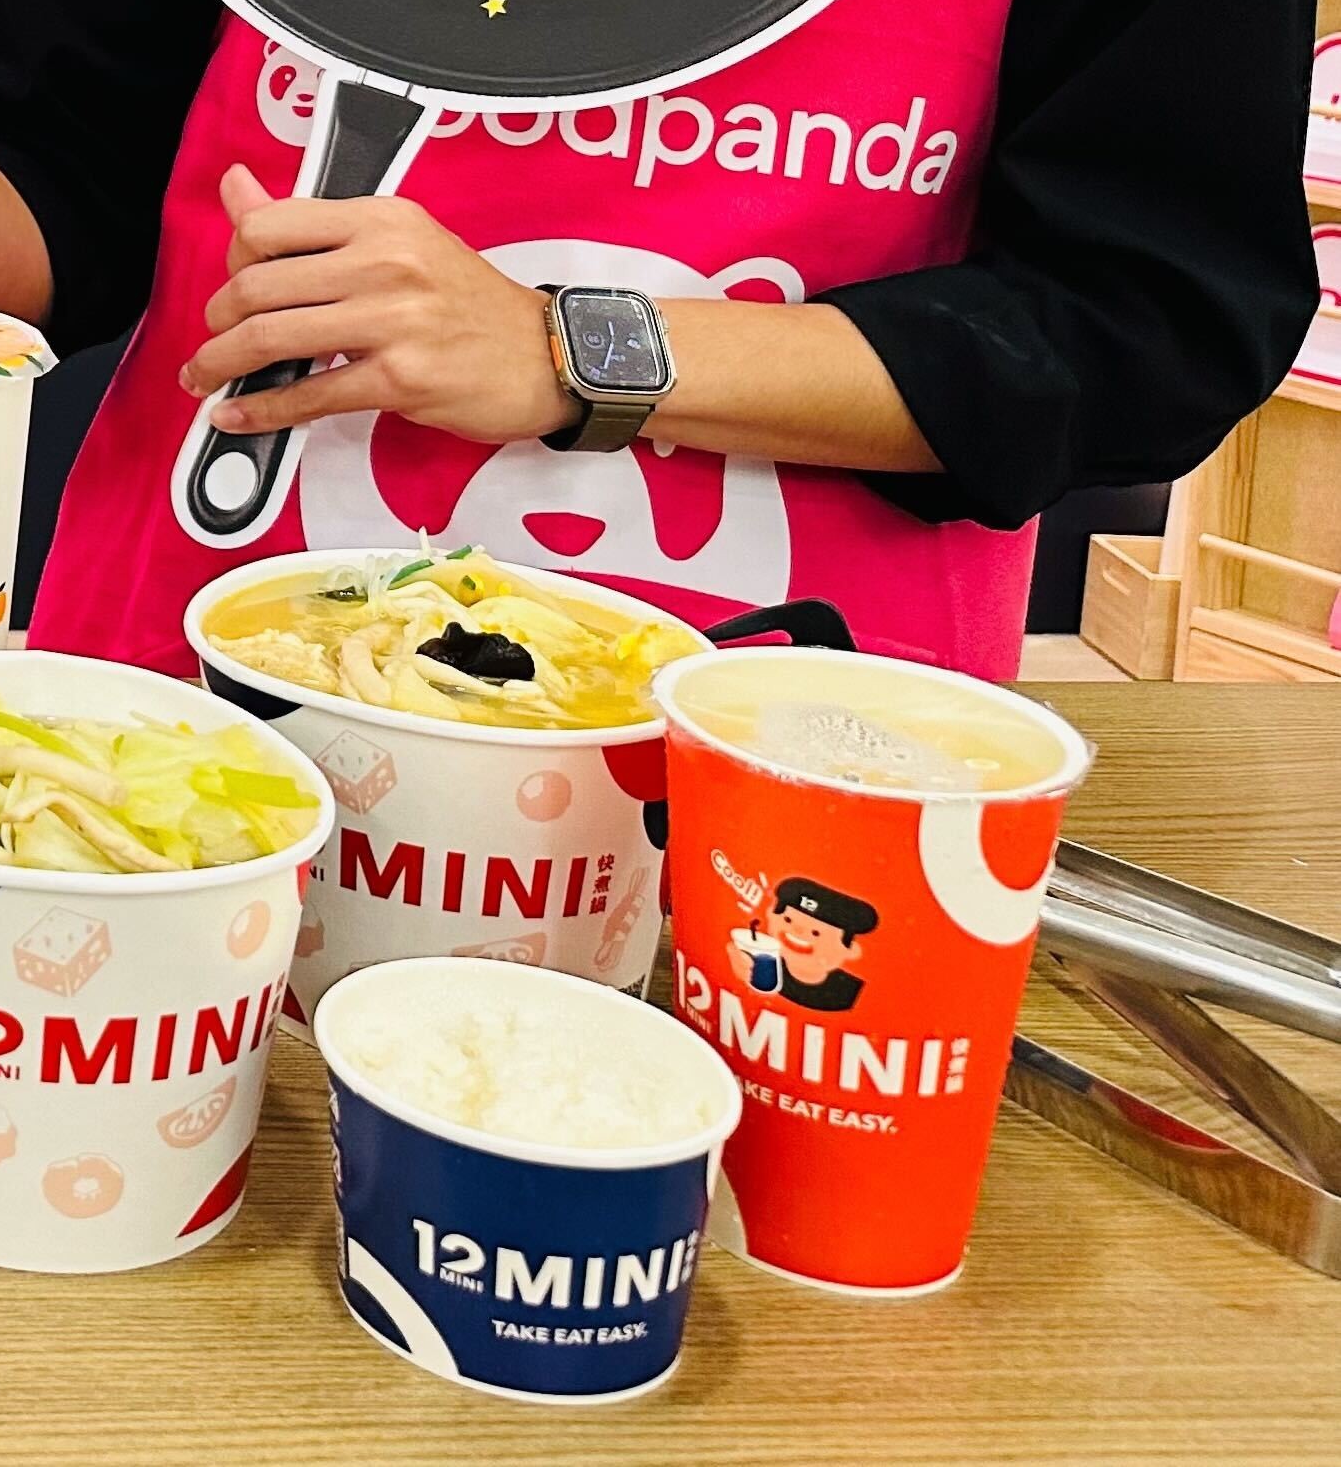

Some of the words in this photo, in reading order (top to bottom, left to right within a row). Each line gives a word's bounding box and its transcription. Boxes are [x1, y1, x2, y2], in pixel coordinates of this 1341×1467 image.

[428, 95, 957, 195] dpanda
[340, 827, 588, 919] MINI
[712, 851, 760, 901] Cool!
[40, 982, 272, 1085] MINI
[675, 948, 712, 1011] 12
[719, 988, 943, 1098] MINI
[777, 1093, 825, 1121] EAT
[828, 1106, 899, 1135] EASY.
[413, 1219, 487, 1276] 12
[495, 1238, 686, 1310] MINI
[439, 1266, 485, 1294] MINI
[491, 1318, 552, 1345] TAKE
[552, 1326, 596, 1346] EAT
[596, 1321, 649, 1345] EASY.
